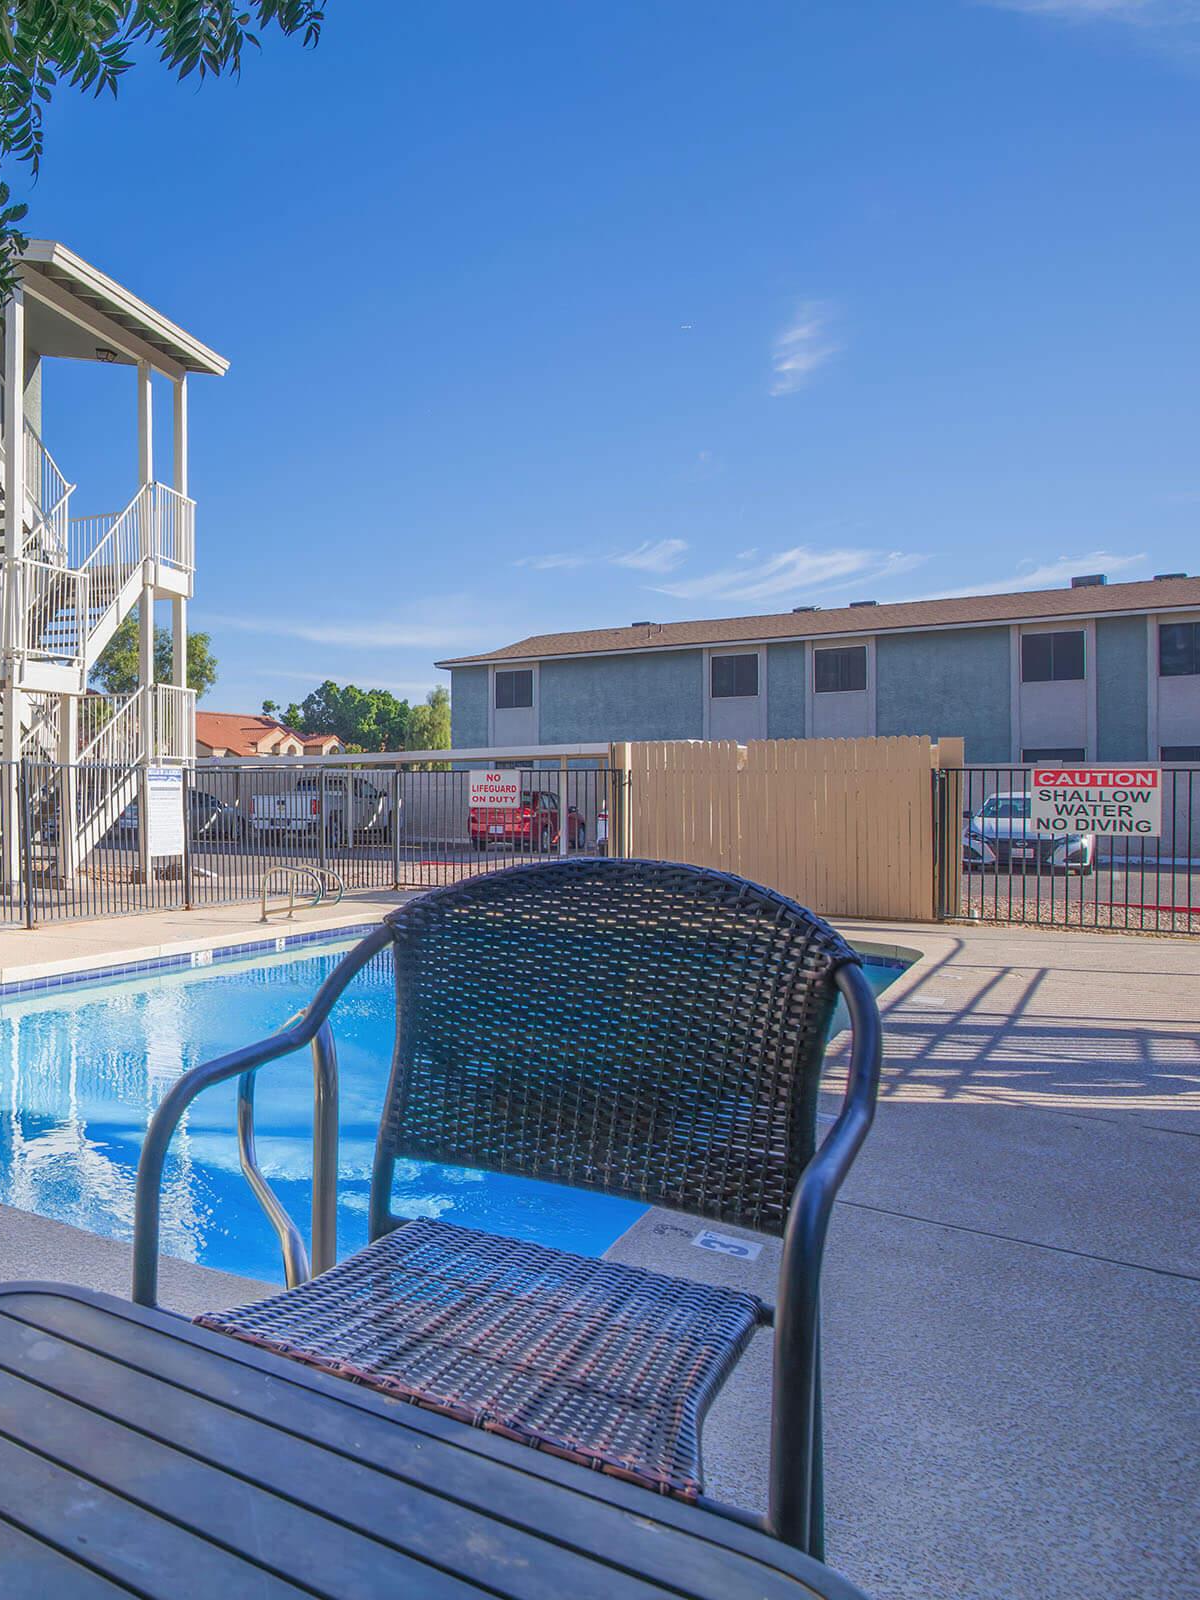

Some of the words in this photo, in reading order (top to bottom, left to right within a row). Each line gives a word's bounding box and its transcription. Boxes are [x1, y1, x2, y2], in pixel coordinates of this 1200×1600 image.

[486, 774, 501, 782] NO
[1038, 772, 1153, 786] CAUTION
[471, 784, 517, 793] LIFEGUARD
[471, 795, 486, 803] ON
[489, 795, 516, 803] DUTY
[1038, 789, 1151, 803] SHALLOW
[1054, 803, 1133, 818] WATER
[1036, 817, 1068, 831] NO
[1075, 818, 1152, 833] DIVING
[700, 1238, 749, 1256] 3
